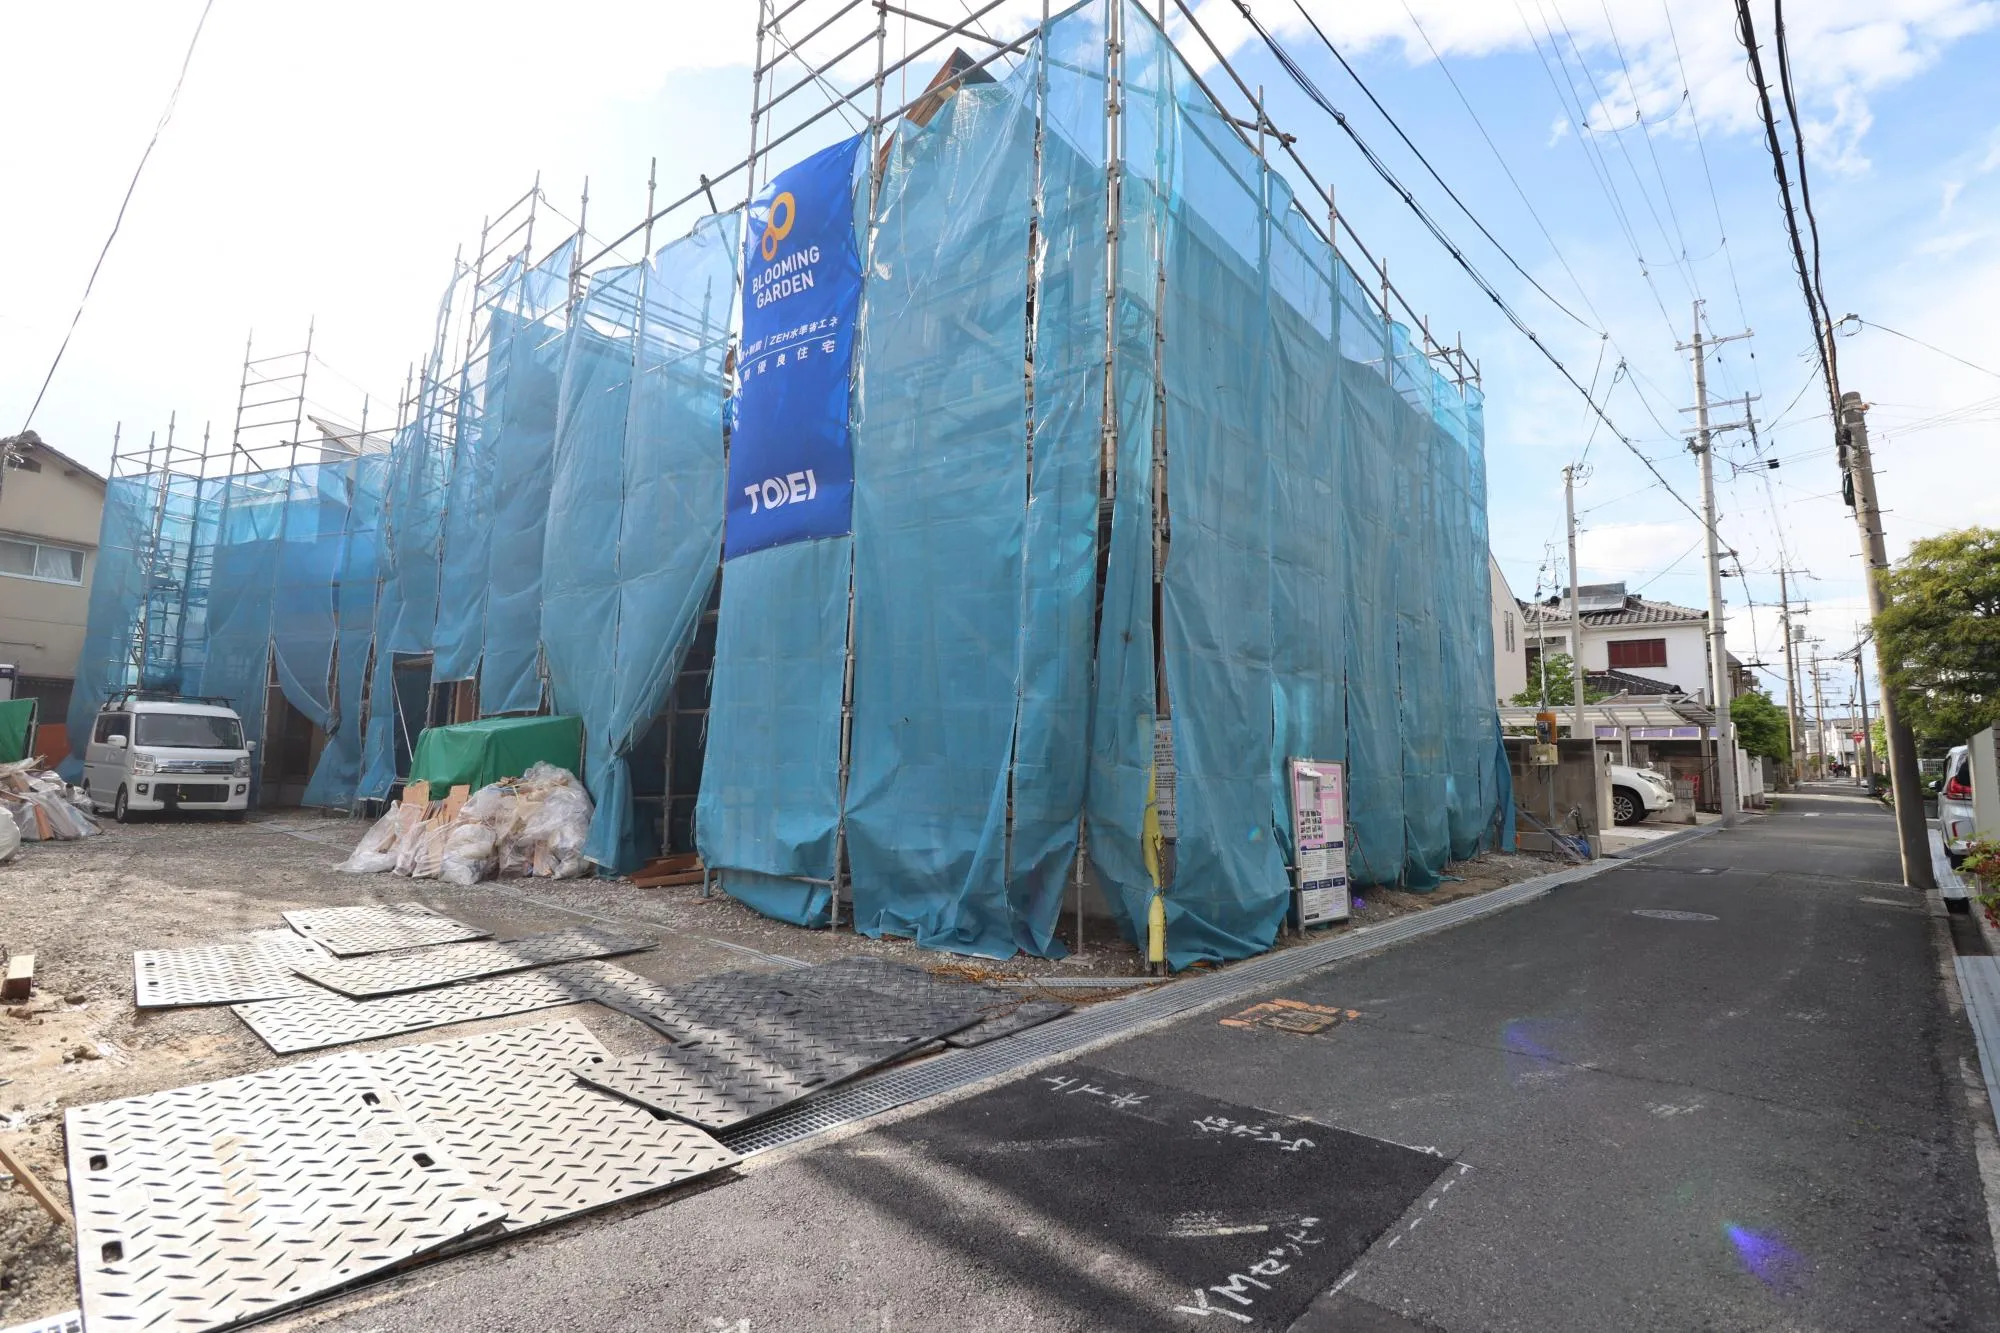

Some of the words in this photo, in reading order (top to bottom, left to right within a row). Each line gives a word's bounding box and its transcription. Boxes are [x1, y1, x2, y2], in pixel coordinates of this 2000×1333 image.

[752, 246, 820, 295] BLOOMING
[756, 270, 815, 309] GARDEN
[744, 468, 817, 515] TOEI
